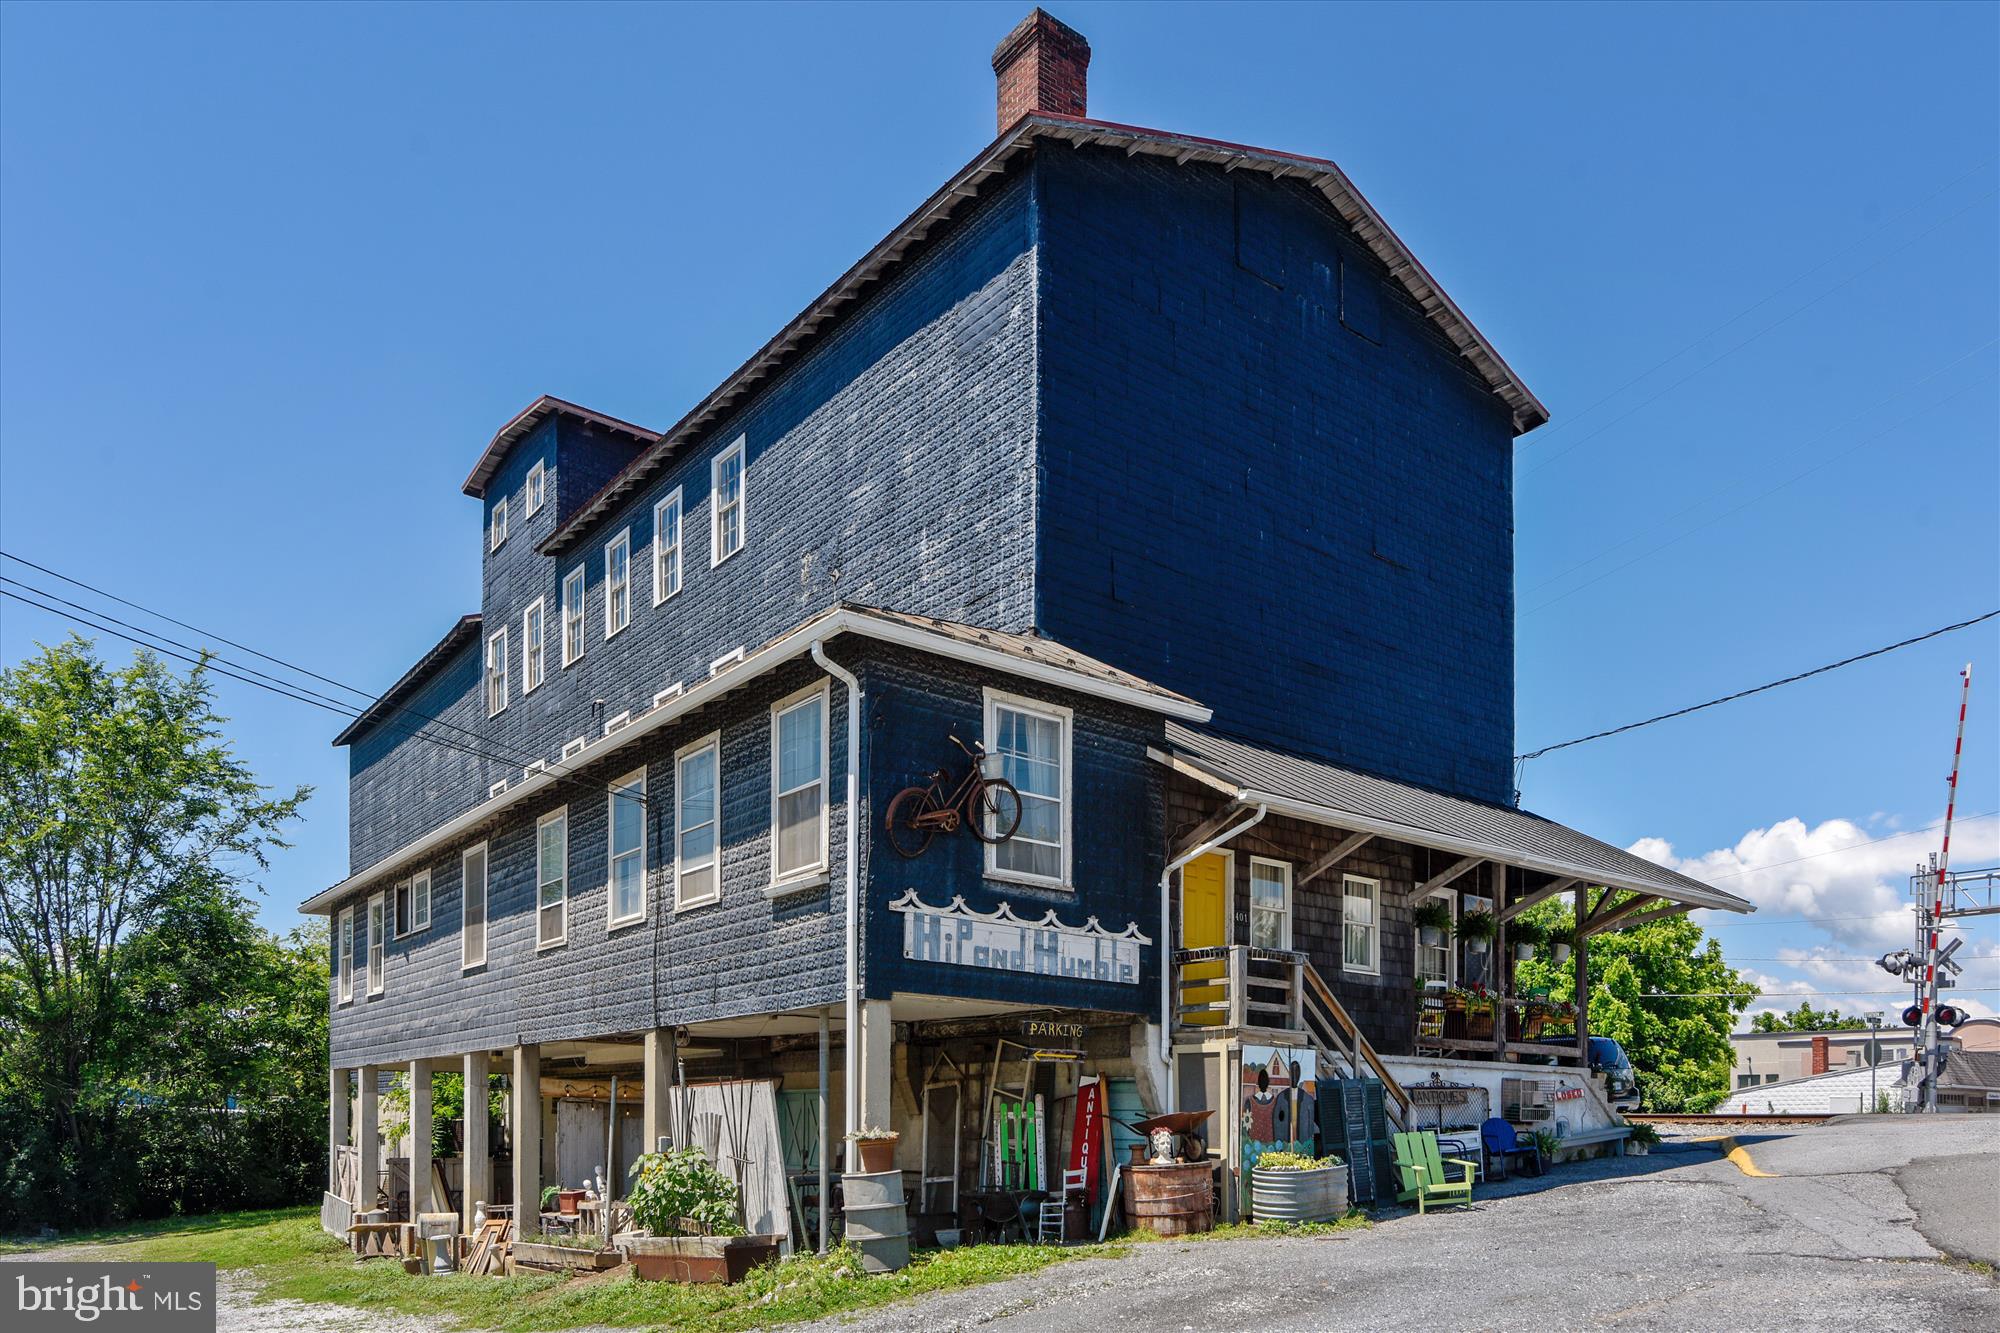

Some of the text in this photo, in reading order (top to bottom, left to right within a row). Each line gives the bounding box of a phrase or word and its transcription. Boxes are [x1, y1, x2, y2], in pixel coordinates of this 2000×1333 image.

[1029, 1022, 1084, 1038] PARKING
[1416, 1090, 1466, 1103] ANTIQUES
[1551, 1088, 1582, 1101] LOSED
